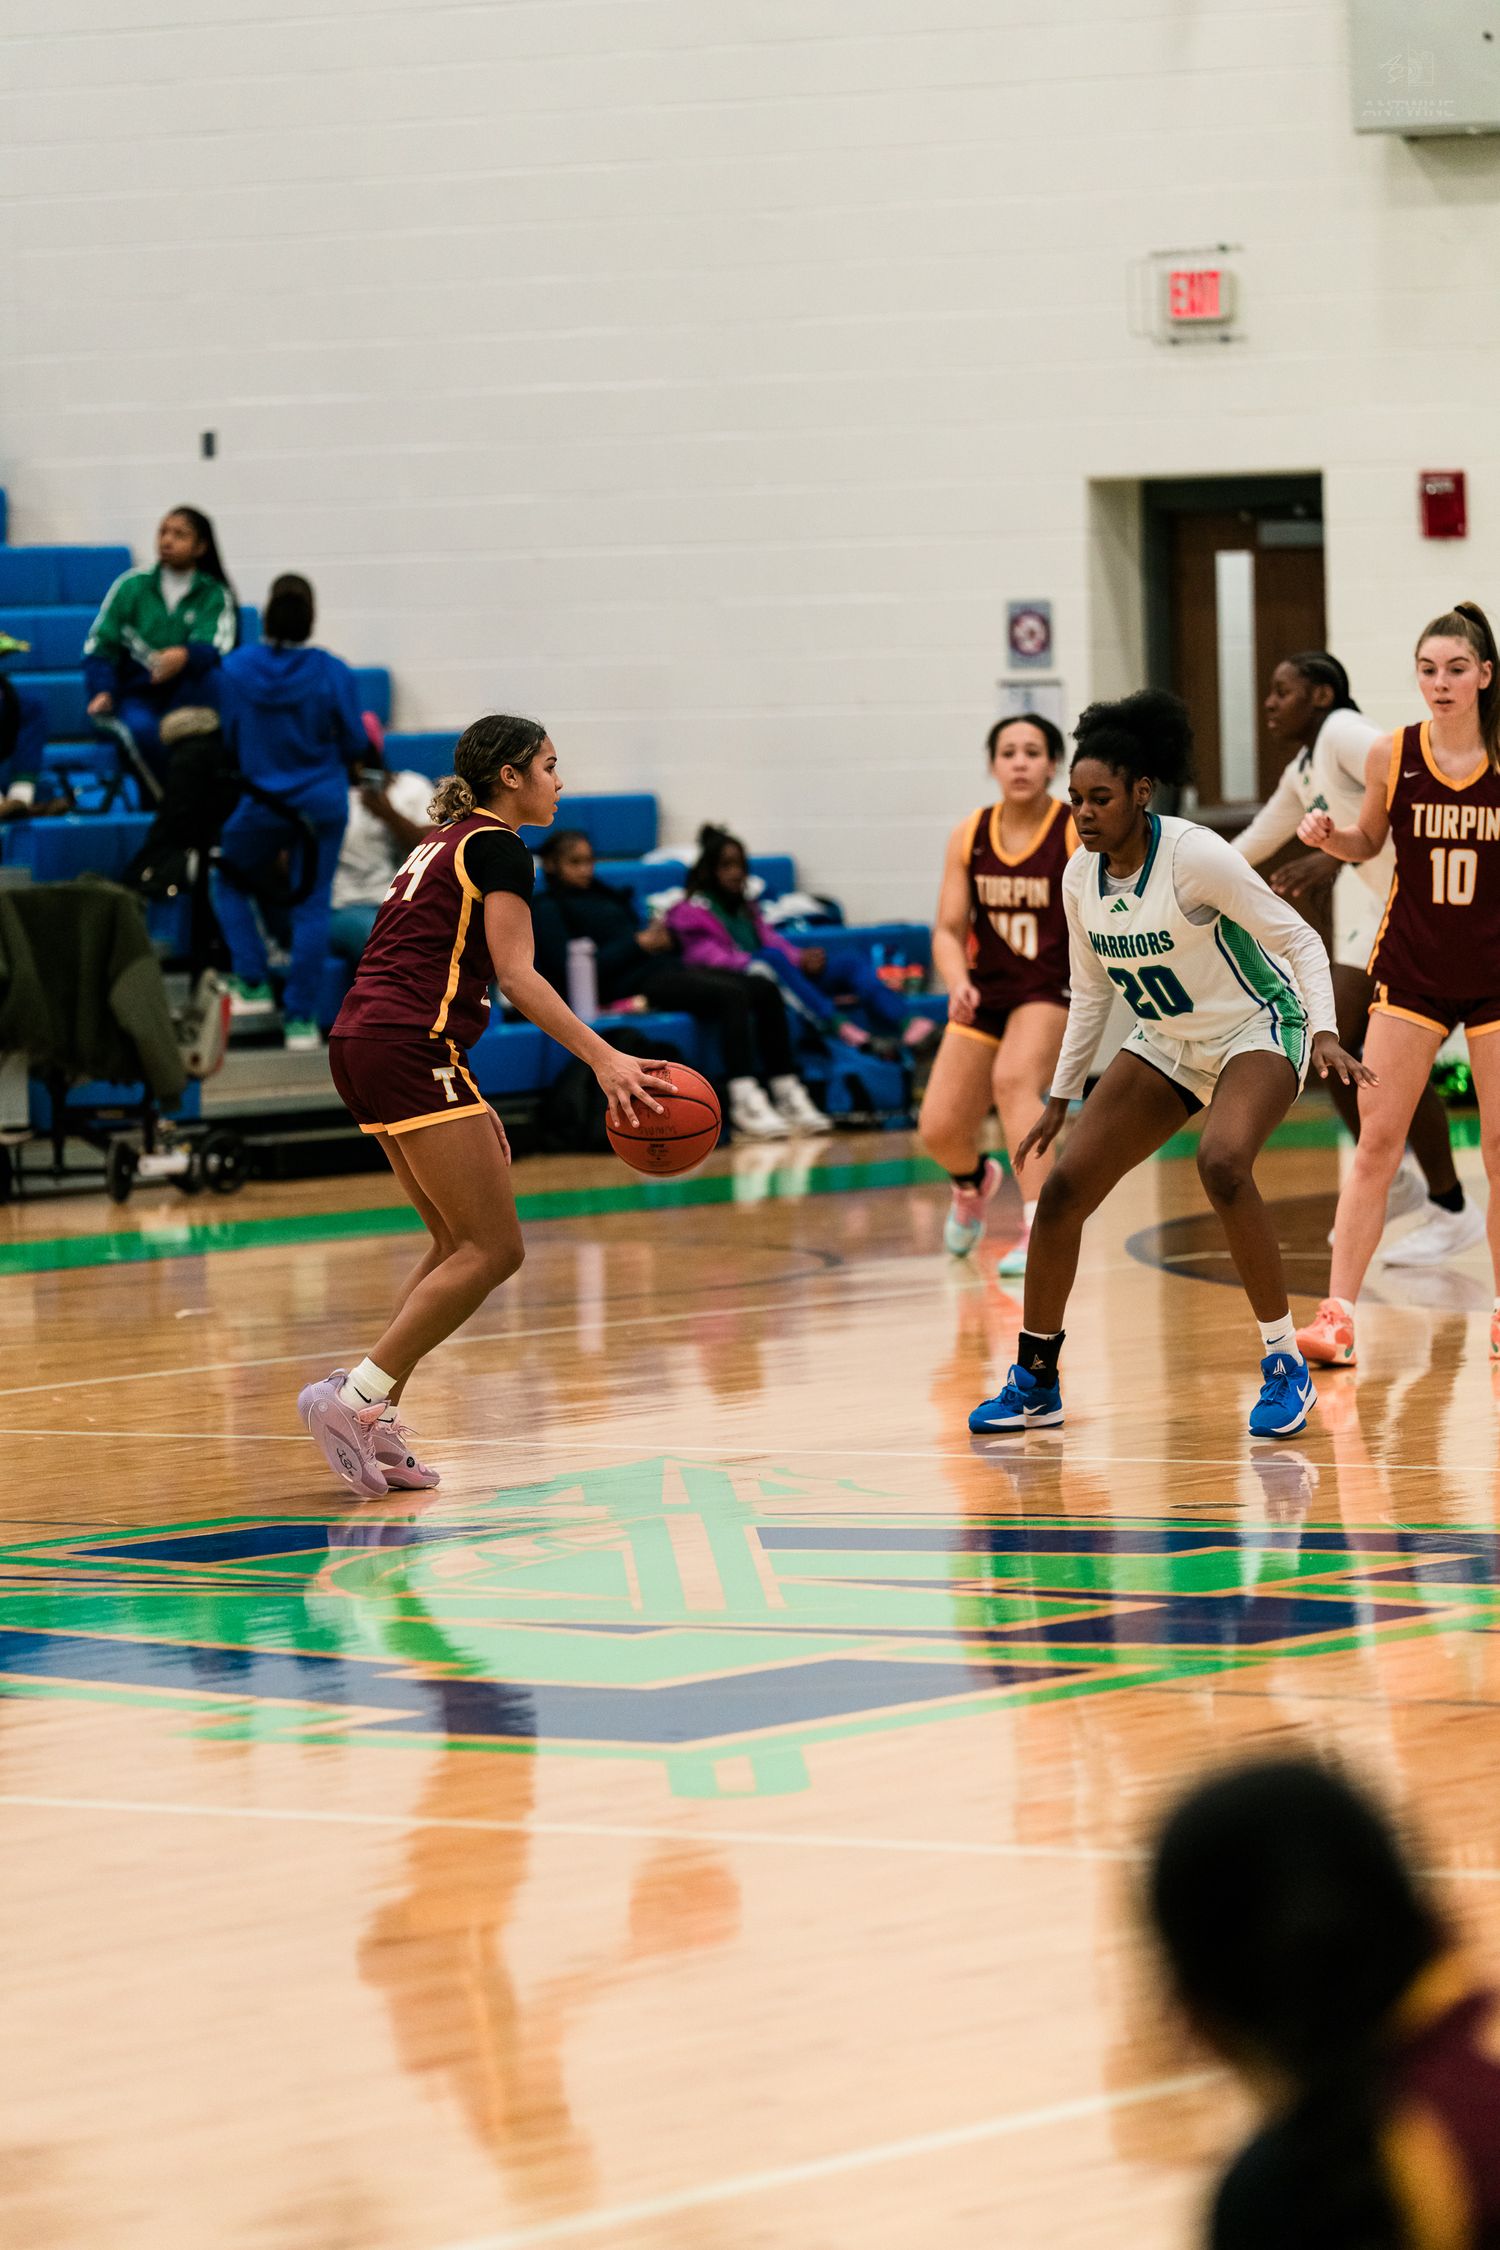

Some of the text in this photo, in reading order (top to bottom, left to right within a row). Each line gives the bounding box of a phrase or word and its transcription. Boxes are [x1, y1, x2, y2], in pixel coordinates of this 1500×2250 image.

[1411, 803, 1500, 841] TURPIN
[383, 841, 447, 902] 24
[1429, 847, 1478, 906] 10
[974, 874, 1050, 908] TURPIN
[1088, 930, 1175, 958] WARRIORS
[1107, 965, 1194, 1021] 20
[431, 1066, 459, 1103] T
